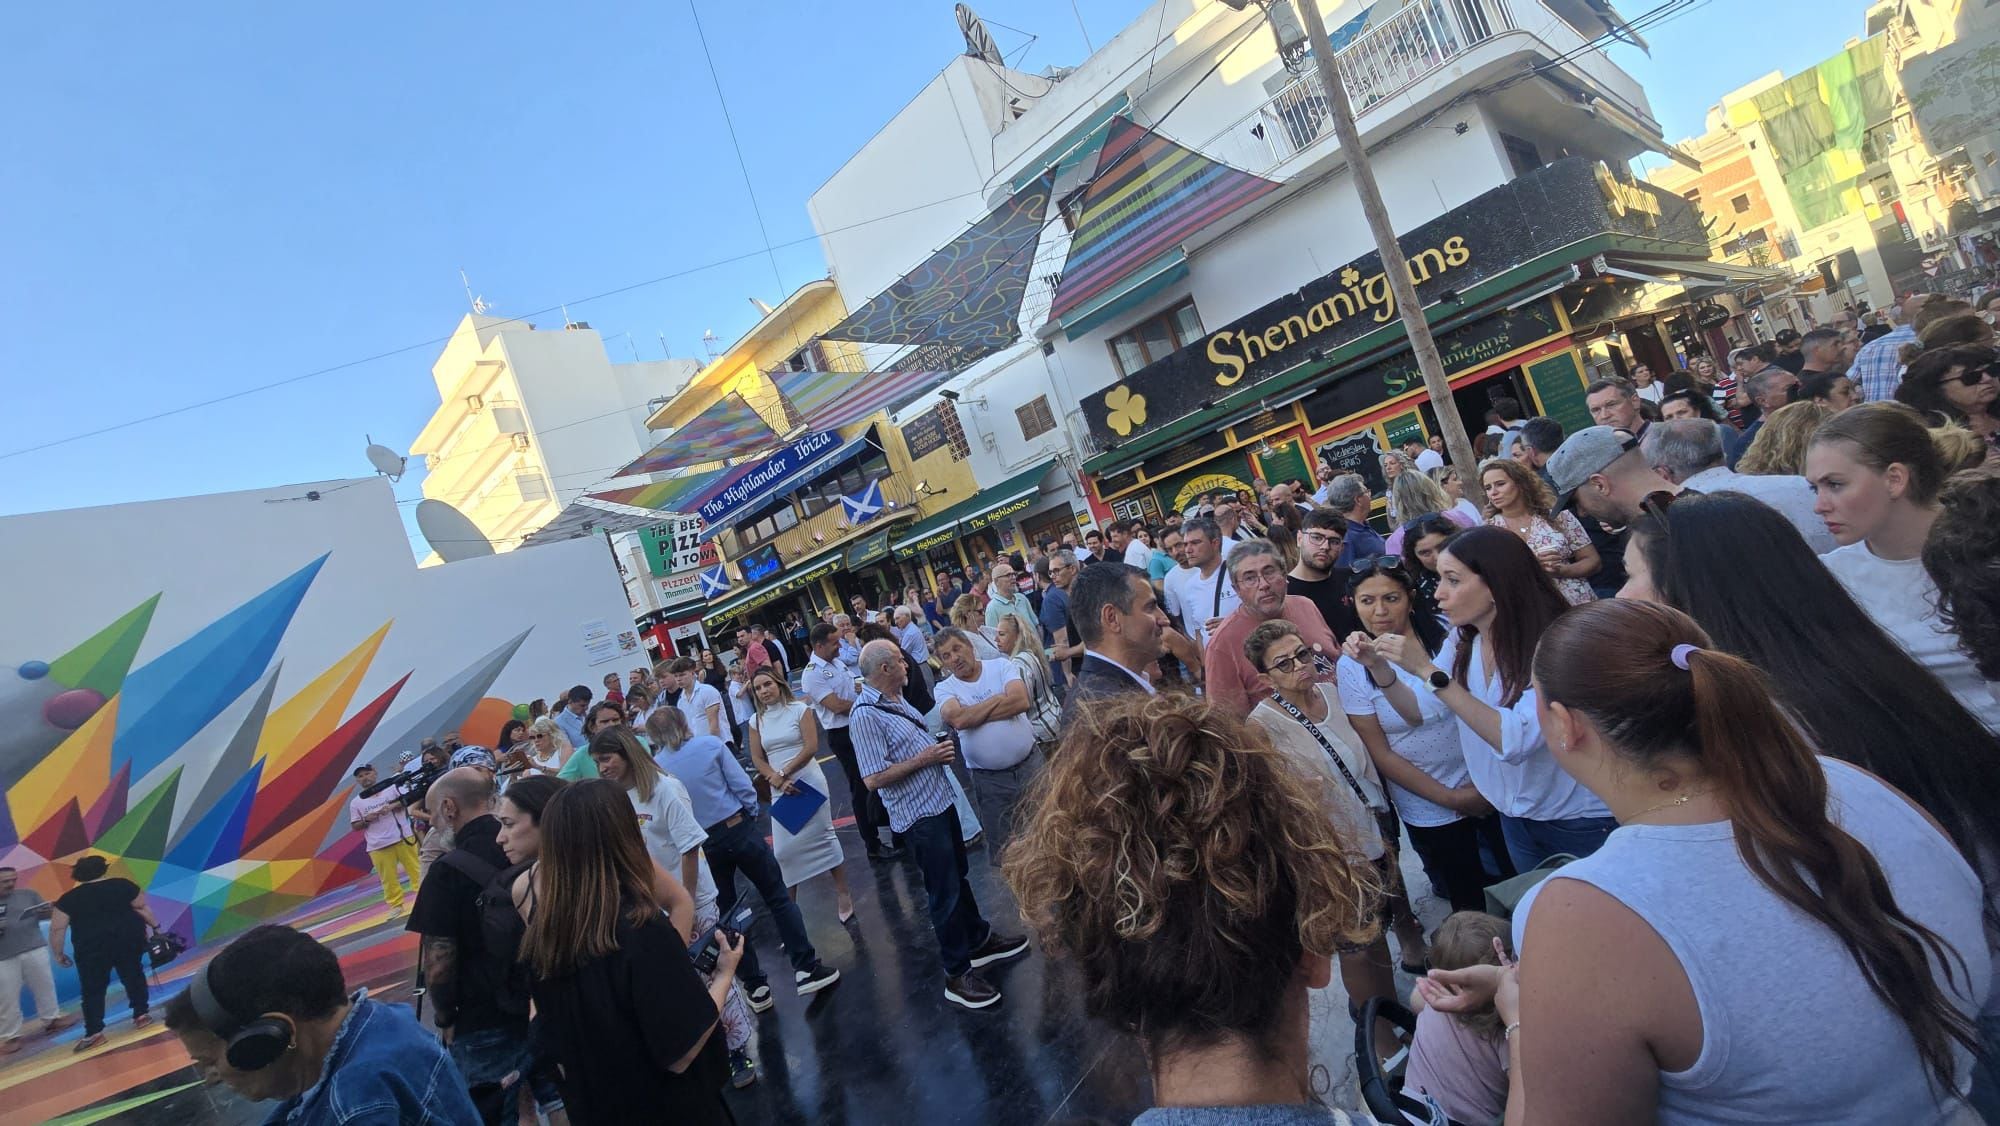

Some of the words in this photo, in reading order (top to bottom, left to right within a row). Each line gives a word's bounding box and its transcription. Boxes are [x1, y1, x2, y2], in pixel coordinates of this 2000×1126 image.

[703, 500, 725, 517] The
[723, 458, 787, 501] Highlander
[794, 431, 832, 461] Ibiza
[970, 518, 985, 529] The
[988, 499, 1030, 522] Highlander
[650, 523, 675, 538] THE
[680, 518, 703, 531] BES
[658, 532, 701, 556] PIZZ
[901, 546, 913, 558] The
[917, 531, 953, 551] Highlander
[663, 558, 678, 571] IN
[796, 577, 805, 586] The
[805, 567, 829, 585] Highlander
[664, 587, 693, 599] Mamma
[715, 614, 724, 624] The
[724, 603, 749, 619] Highlander
[1280, 700, 1301, 717] LOVE
[1302, 719, 1322, 739] LOVE
[1323, 742, 1341, 763] LOVE
